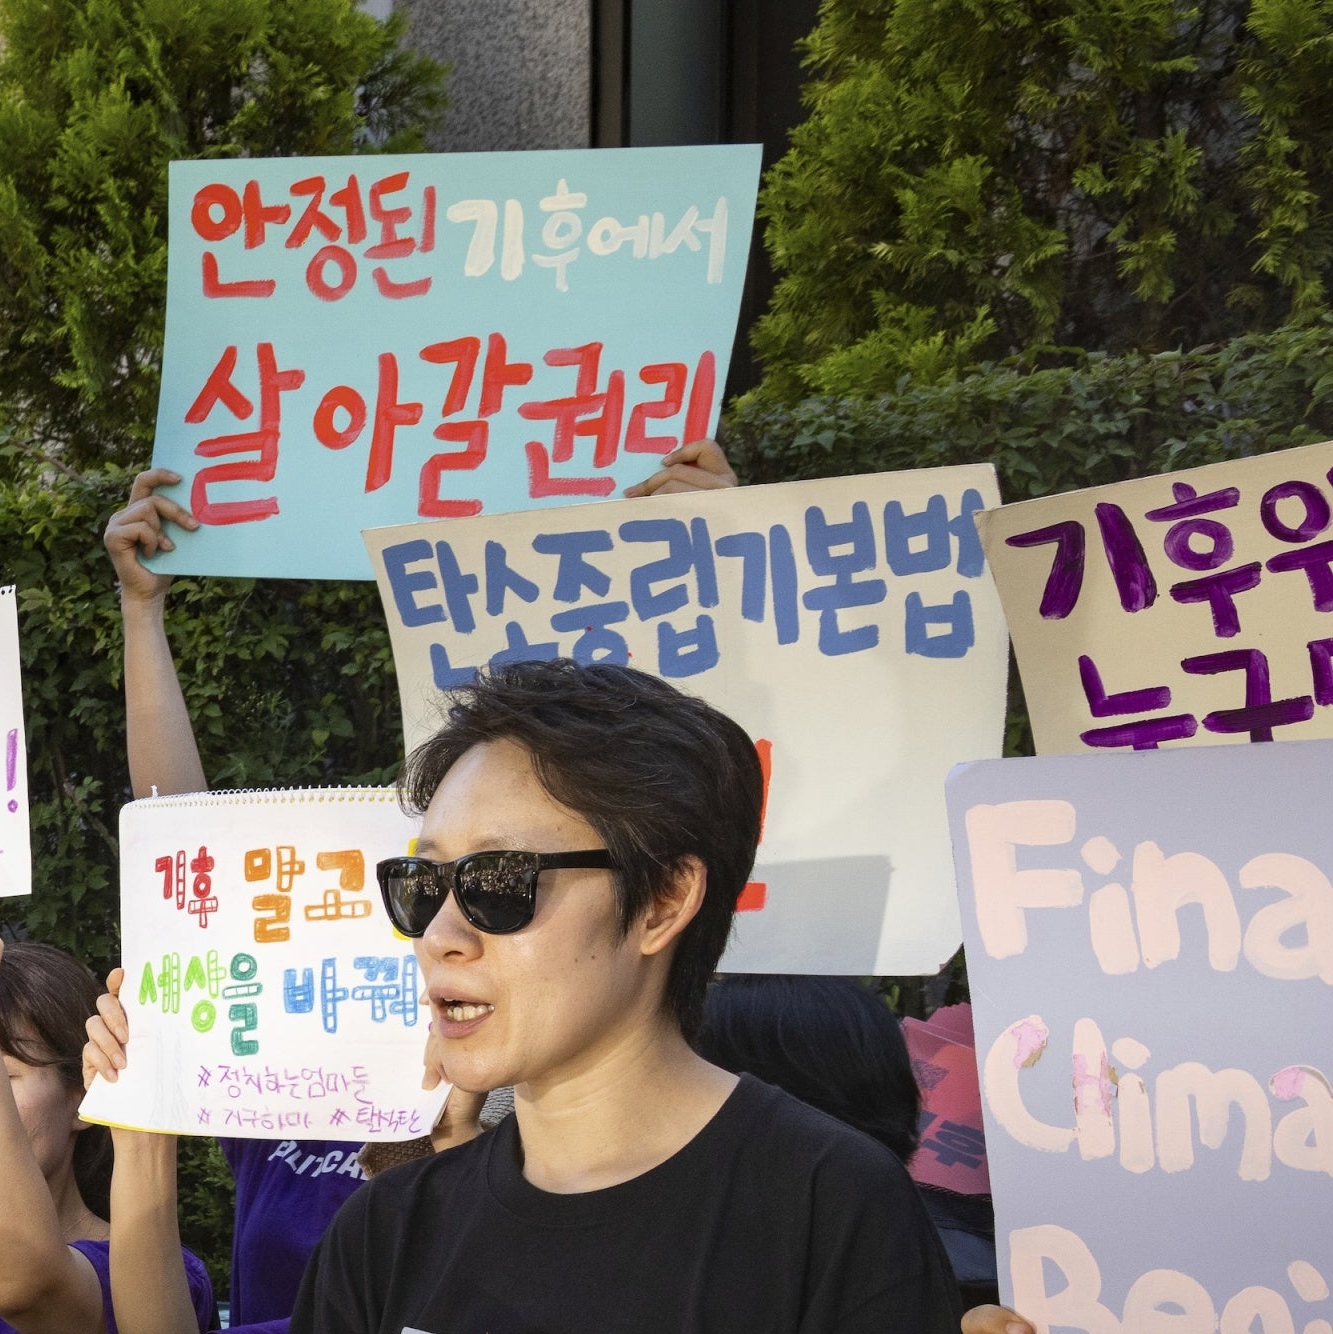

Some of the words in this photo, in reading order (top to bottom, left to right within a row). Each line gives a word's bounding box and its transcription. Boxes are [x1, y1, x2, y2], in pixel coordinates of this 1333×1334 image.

[190, 171, 435, 301] 안정된
[445, 177, 728, 293] 기후에서
[155, 846, 218, 928] 기후
[139, 950, 262, 1056] 세상을
